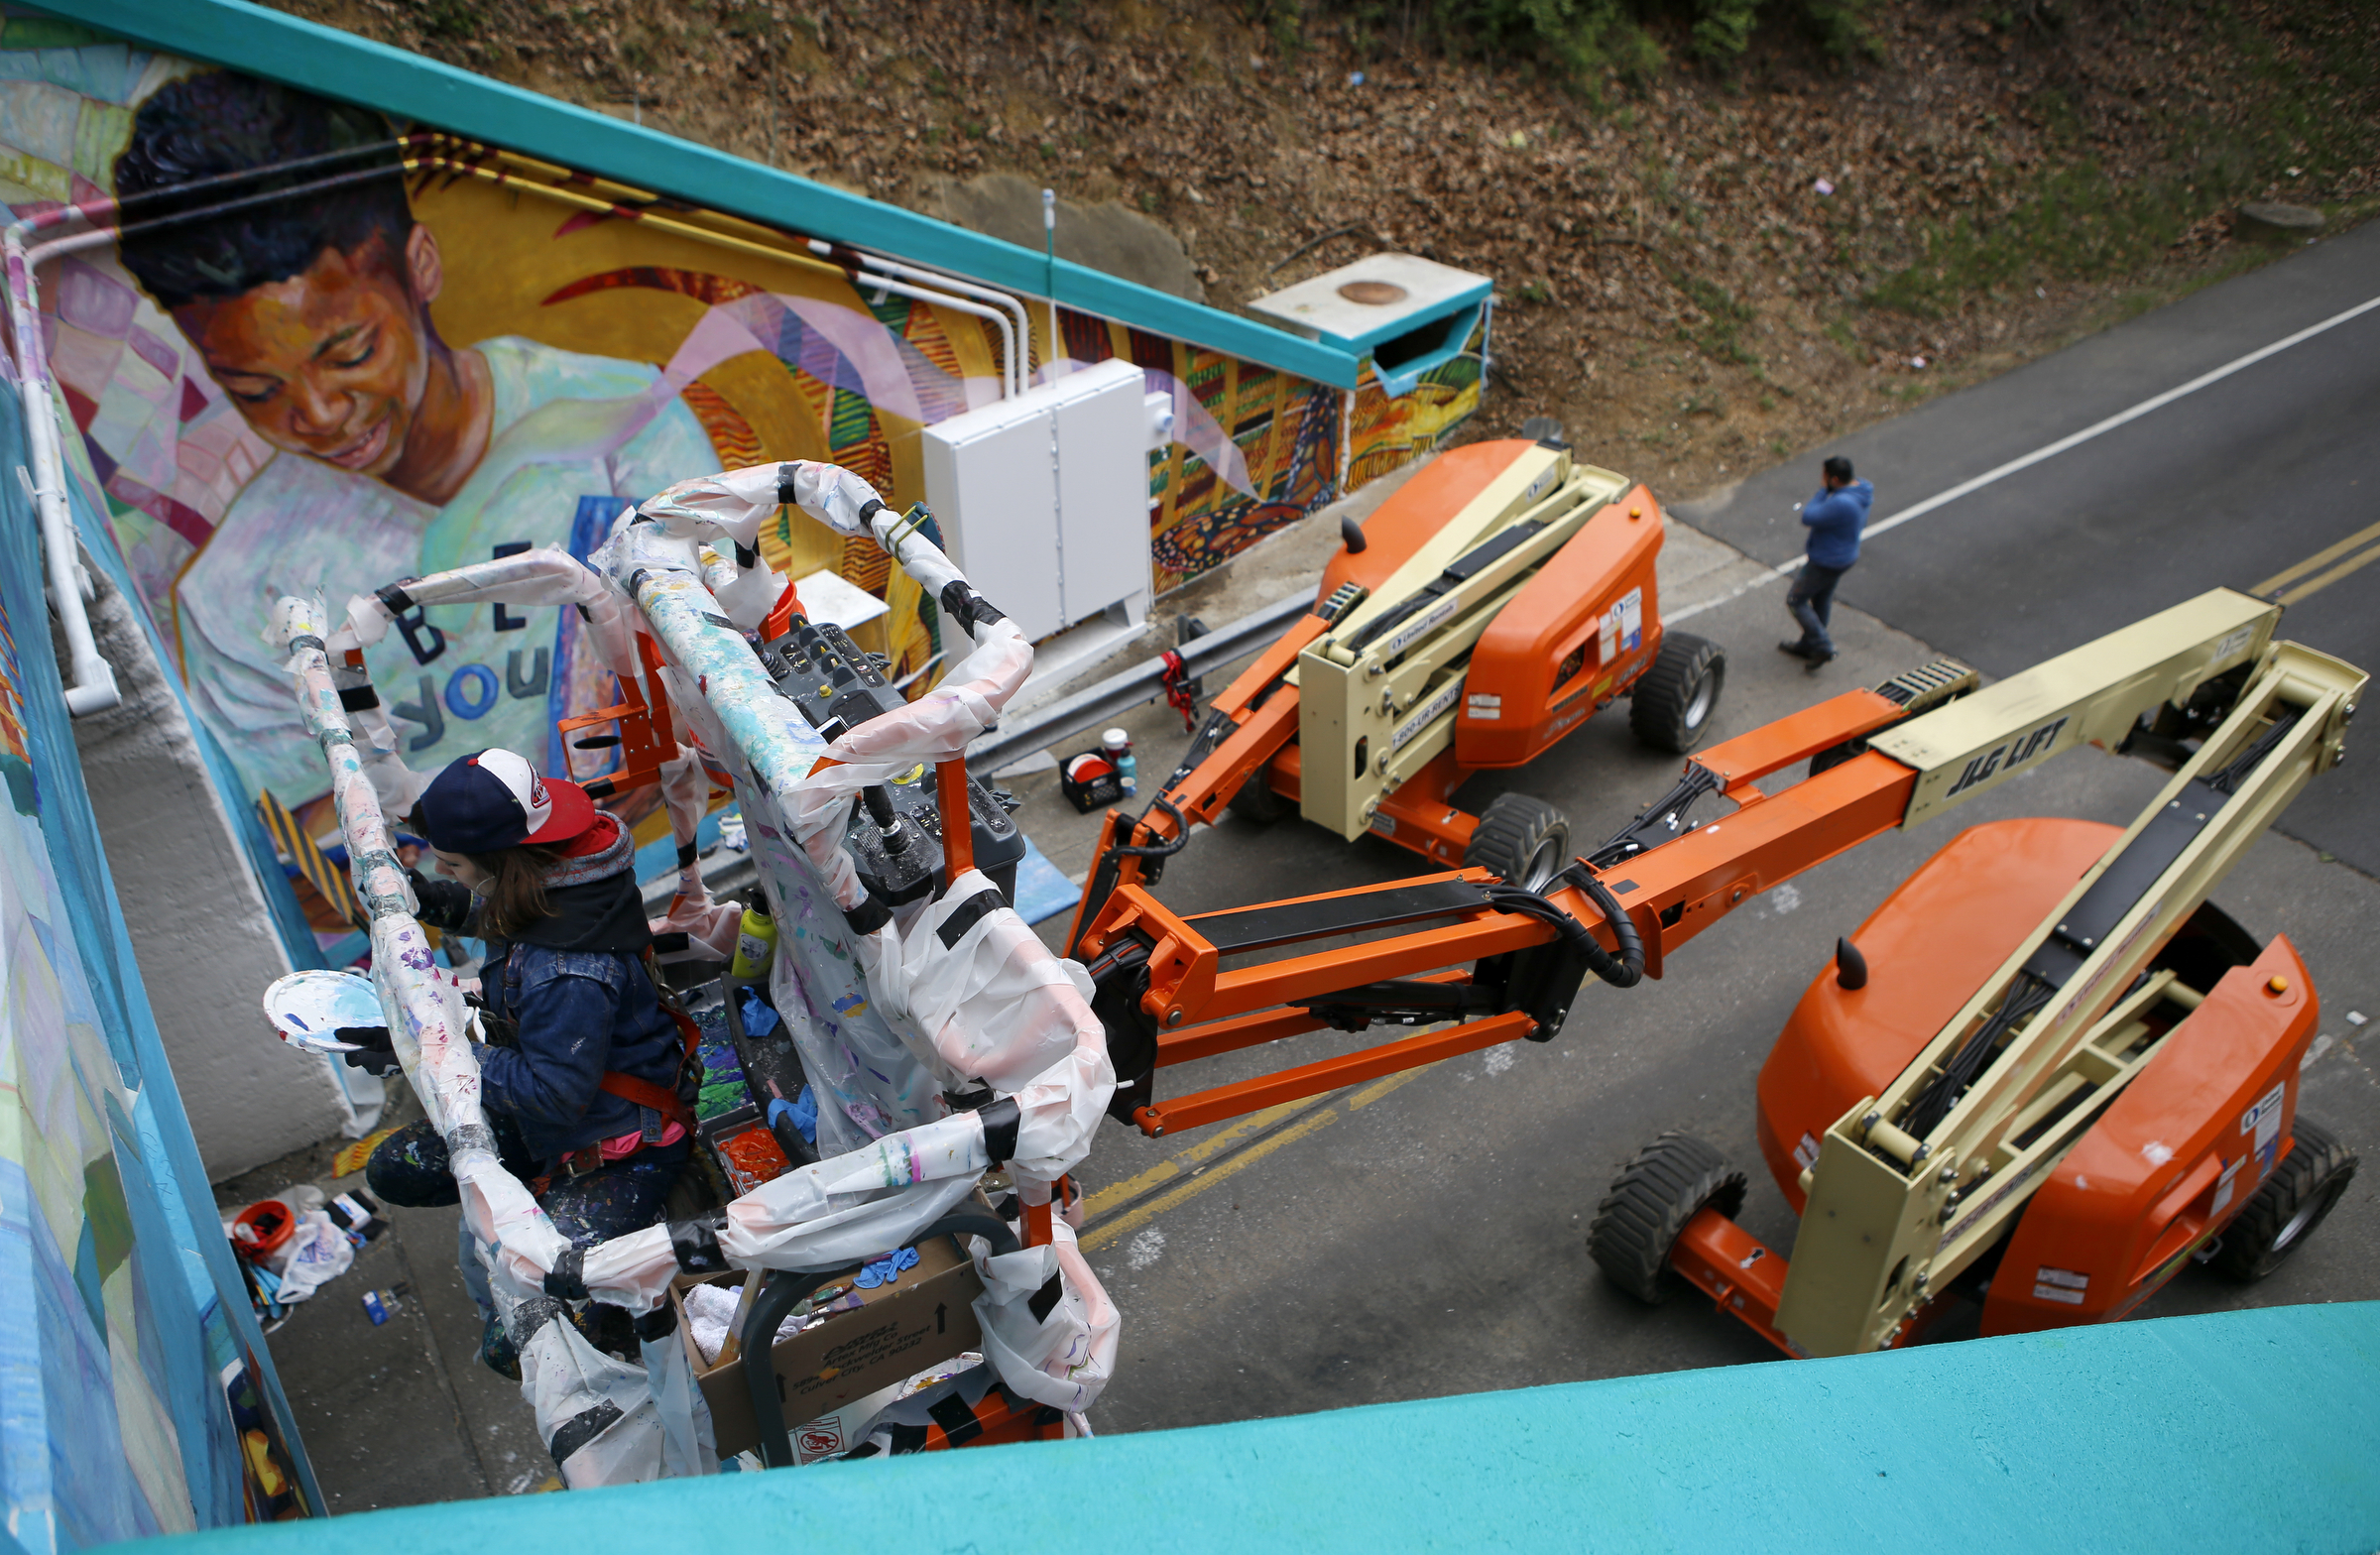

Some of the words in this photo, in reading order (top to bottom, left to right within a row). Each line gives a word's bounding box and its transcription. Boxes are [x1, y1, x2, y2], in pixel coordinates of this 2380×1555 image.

[1946, 744, 2008, 798] JLG
[2002, 715, 2070, 771] LIFT
[799, 1375, 838, 1395] Culver
[869, 1356, 885, 1366] CA
[889, 1337, 922, 1357] 90232
[824, 1350, 857, 1369] Artex
[858, 1339, 881, 1355] Mfg
[884, 1332, 898, 1342] Co
[831, 1342, 892, 1370] lackwelder
[896, 1325, 931, 1345] Street
